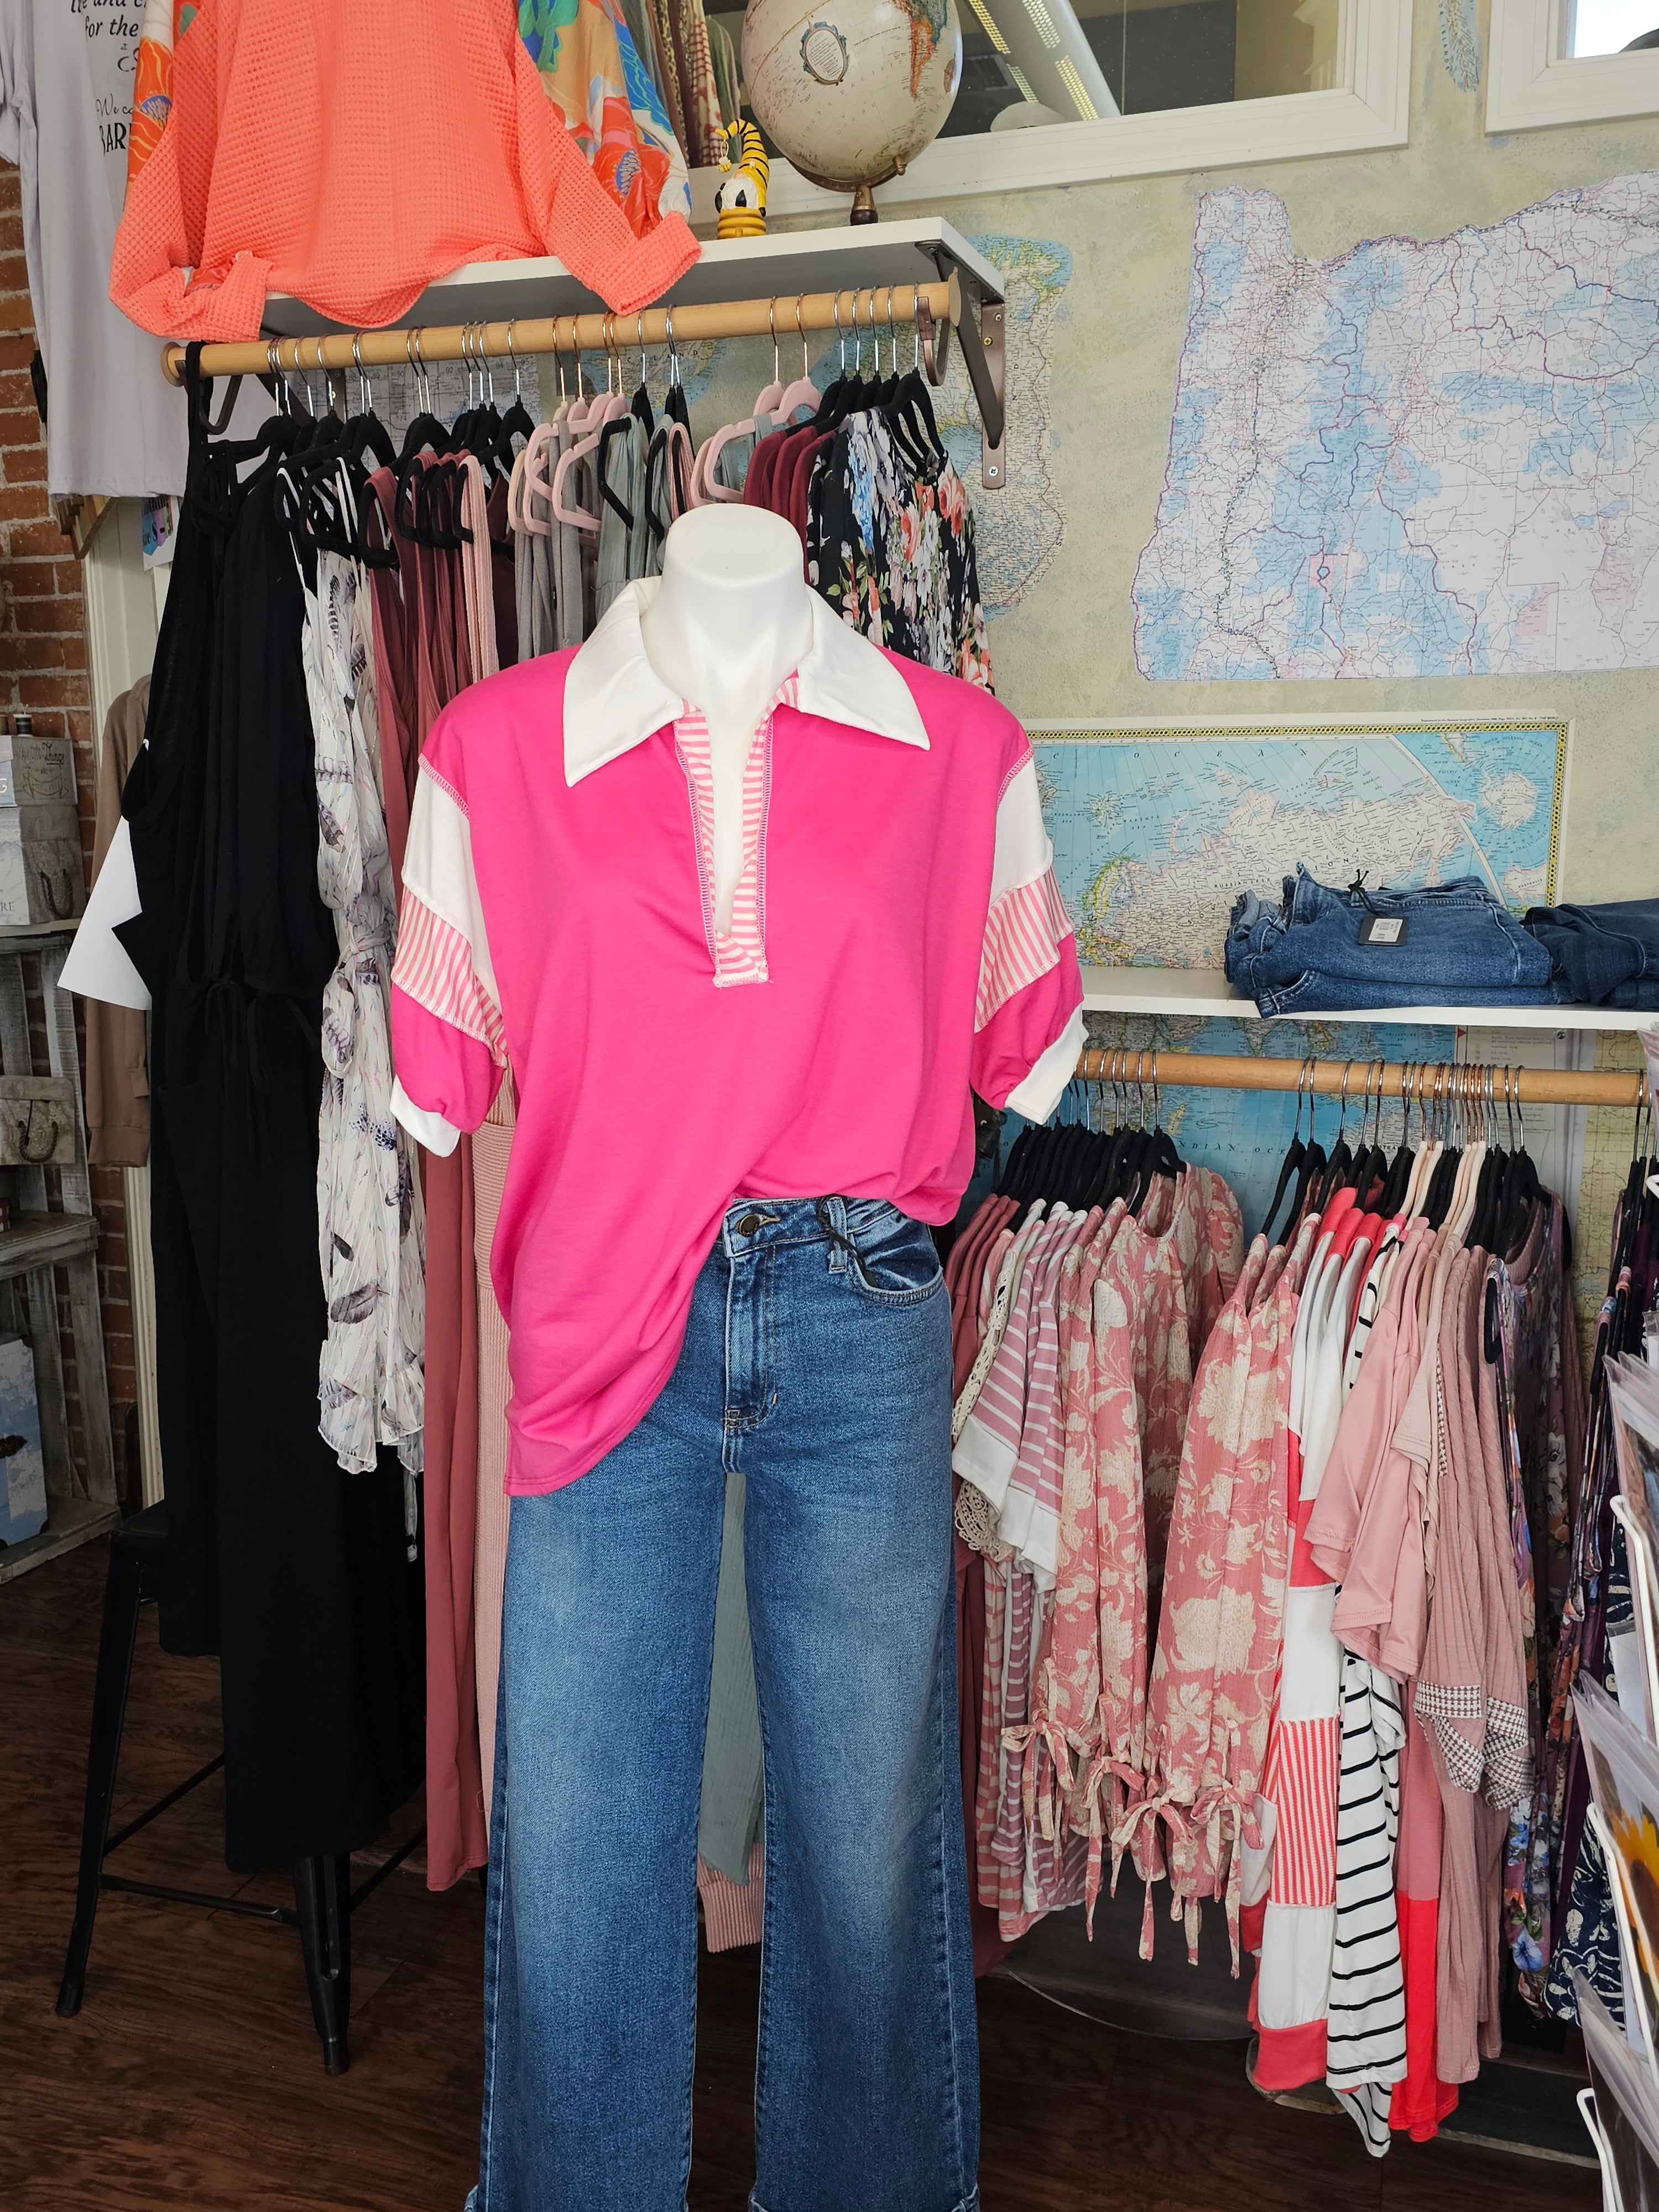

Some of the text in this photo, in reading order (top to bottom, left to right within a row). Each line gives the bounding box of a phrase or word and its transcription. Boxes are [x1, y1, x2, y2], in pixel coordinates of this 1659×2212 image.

[85, 14, 139, 40] for the
[96, 93, 119, 117] We
[1518, 878, 1543, 888] AUSTRALIA
